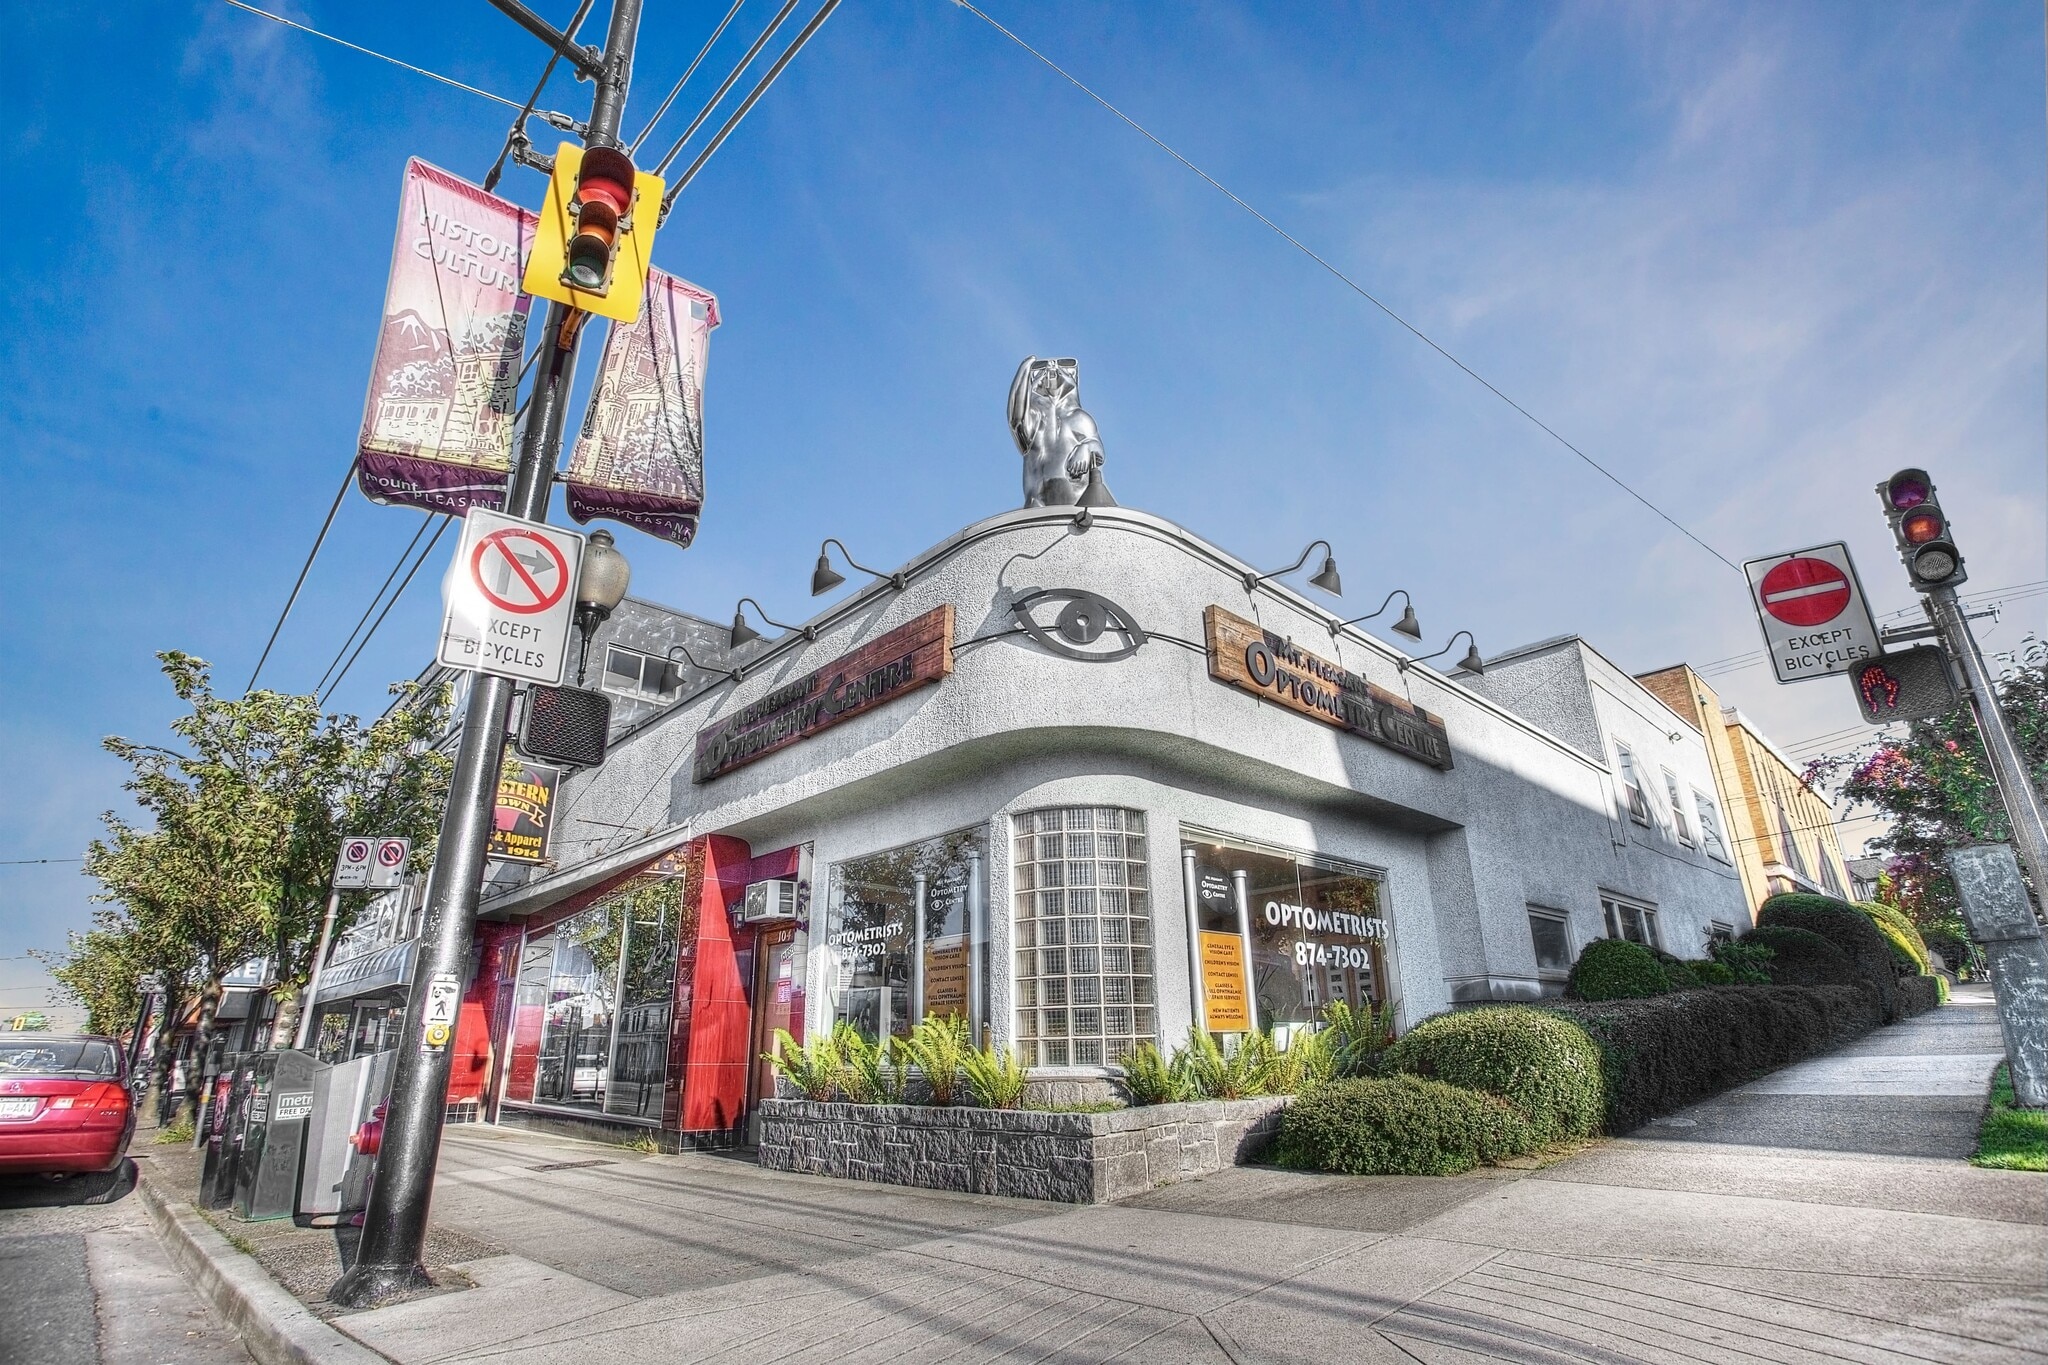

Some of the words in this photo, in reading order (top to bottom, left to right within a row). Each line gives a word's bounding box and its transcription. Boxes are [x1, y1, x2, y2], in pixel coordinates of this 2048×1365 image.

[366, 472, 418, 493] mount
[414, 491, 502, 510] PLEASANT
[626, 512, 691, 538] LEASANT
[487, 618, 542, 643] XCEPT
[1789, 627, 1853, 651] EXCEPT
[464, 639, 545, 668] BICYCLES
[1785, 645, 1870, 671] BICYCLES
[1307, 656, 1370, 698] PLEASANT
[1246, 641, 1379, 738] OPTOMETRY
[1379, 704, 1442, 759] CENTRE
[704, 699, 820, 772] OPTOMETRY
[822, 654, 915, 715] CENTRE
[496, 797, 530, 811] OWN
[498, 779, 550, 807] STERN
[504, 832, 542, 847] Apparel
[507, 846, 540, 858] 1914
[1265, 901, 1389, 940] OPTOMETRISTS
[828, 922, 903, 946] OPTOMETRISTS
[842, 941, 886, 960] 874-7302
[1295, 941, 1371, 970] 874-7302
[279, 1108, 297, 1116] FREE
[281, 1094, 313, 1107] metr
